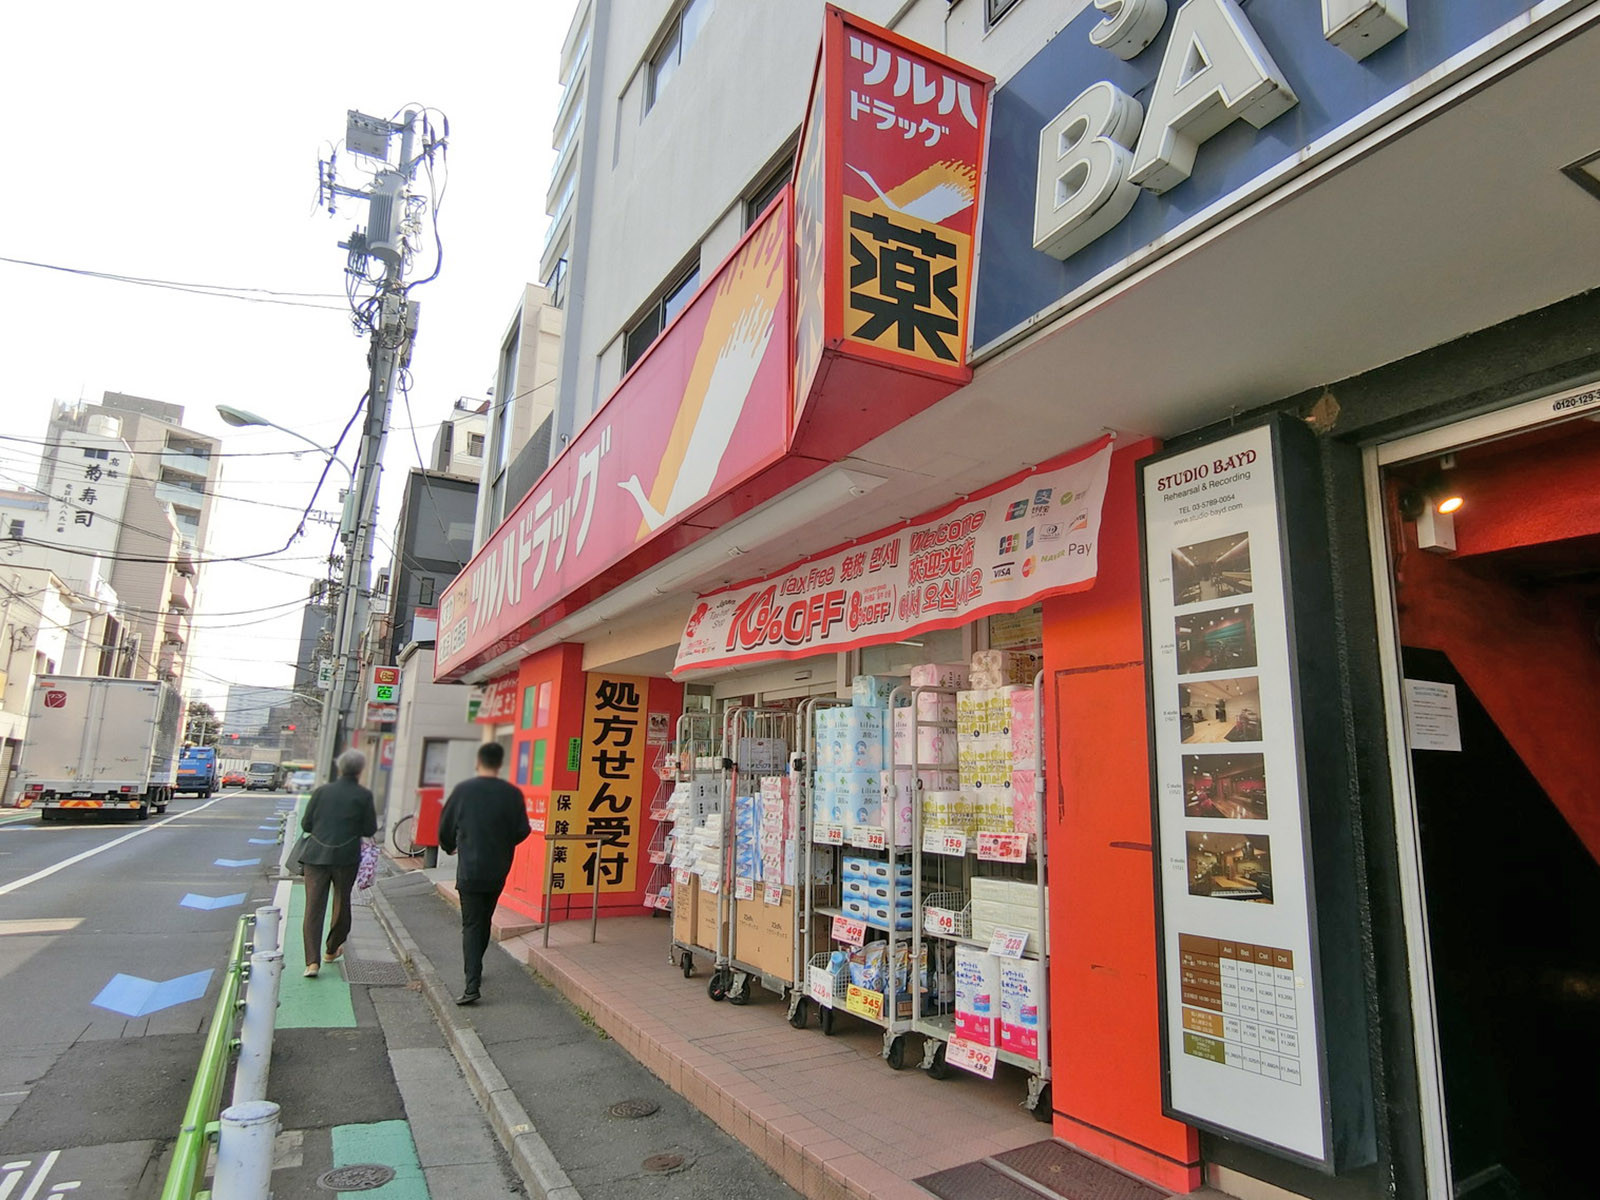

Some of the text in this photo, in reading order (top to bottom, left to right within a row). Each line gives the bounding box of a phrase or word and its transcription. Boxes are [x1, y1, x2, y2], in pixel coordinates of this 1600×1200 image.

[849, 35, 979, 130] ツルハ
[849, 90, 949, 148] ドラッグ
[850, 210, 959, 362] 薬
[1157, 449, 1257, 491] STUDIO BAYD
[1163, 471, 1251, 502] Rehearsal & Recording
[1179, 505, 1191, 514] TEL
[472, 424, 611, 636] ツルハドラッグ
[999, 533, 1020, 555] JCB
[1068, 542, 1093, 556] Pay
[908, 537, 976, 588] 欢迎光临
[994, 567, 1011, 578] VISA
[808, 566, 835, 591] Free
[582, 680, 640, 886] 処方せん受付
[551, 794, 572, 889] 保険薬局
[828, 830, 841, 839] 328
[868, 835, 883, 844] 328
[945, 838, 962, 848] 158
[846, 926, 862, 937] 498
[939, 916, 952, 928] 68
[1005, 938, 1022, 950] 228
[862, 996, 880, 1009] 345
